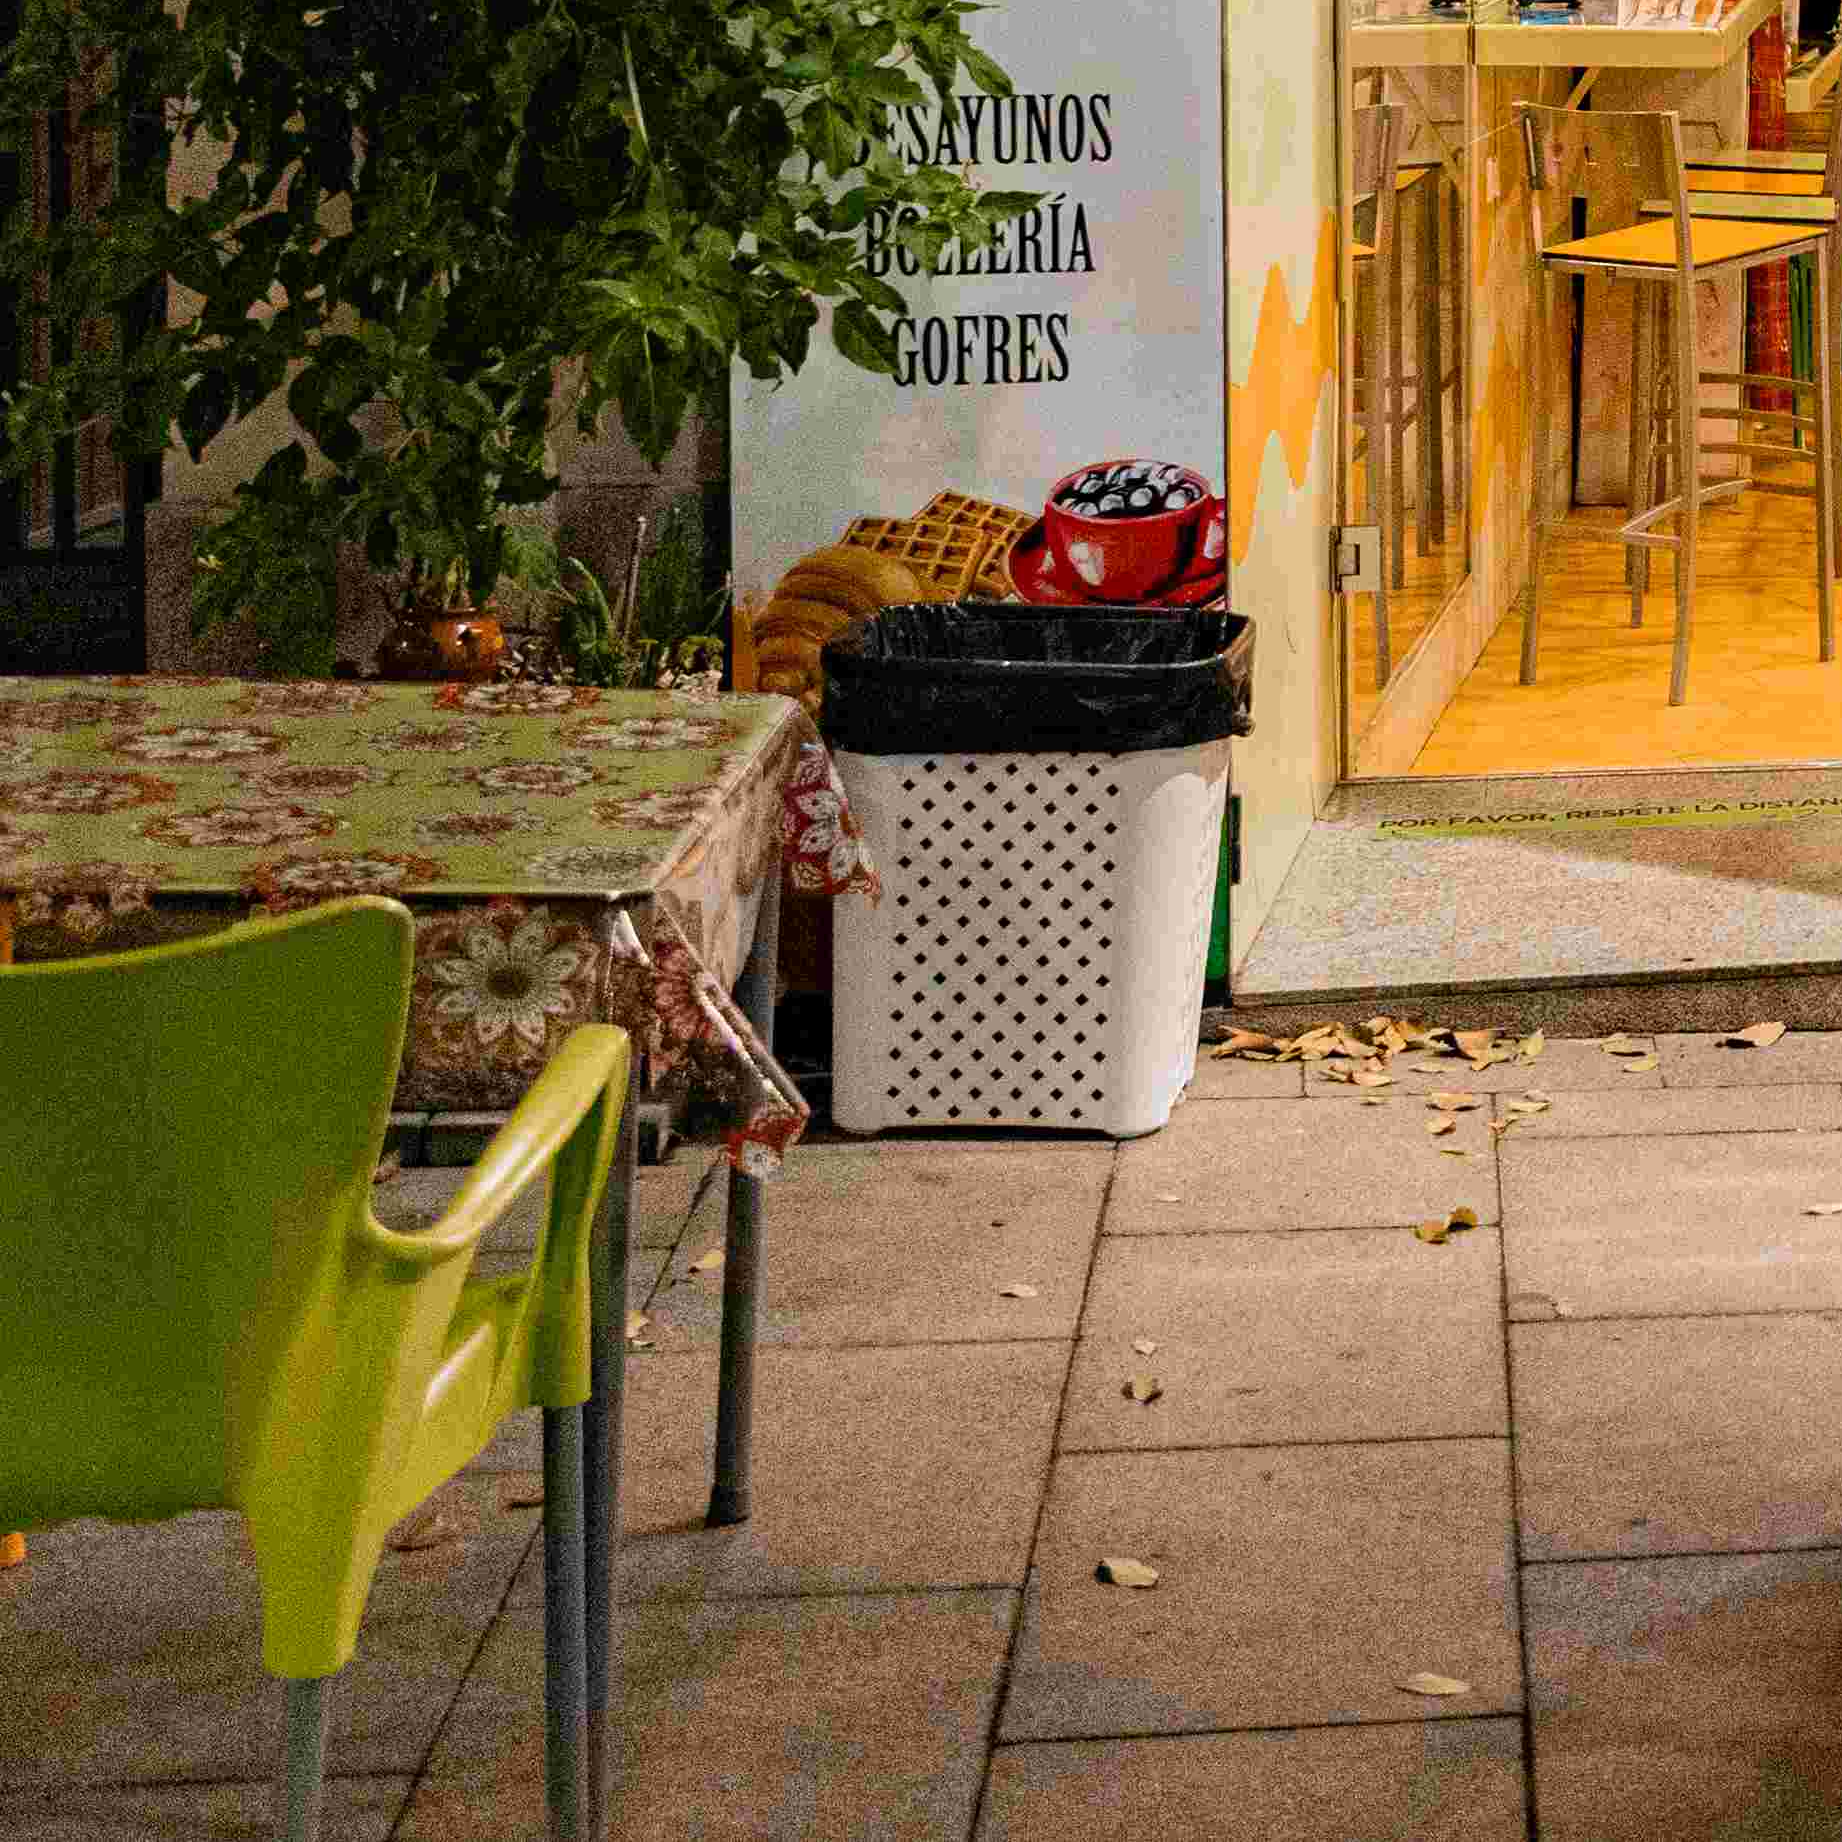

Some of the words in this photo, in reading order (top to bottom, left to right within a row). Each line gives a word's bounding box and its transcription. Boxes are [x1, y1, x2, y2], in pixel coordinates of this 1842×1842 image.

[892, 314, 1068, 386] GOFRES
[1379, 818, 1436, 829] POR
[1696, 804, 1728, 813] LA
